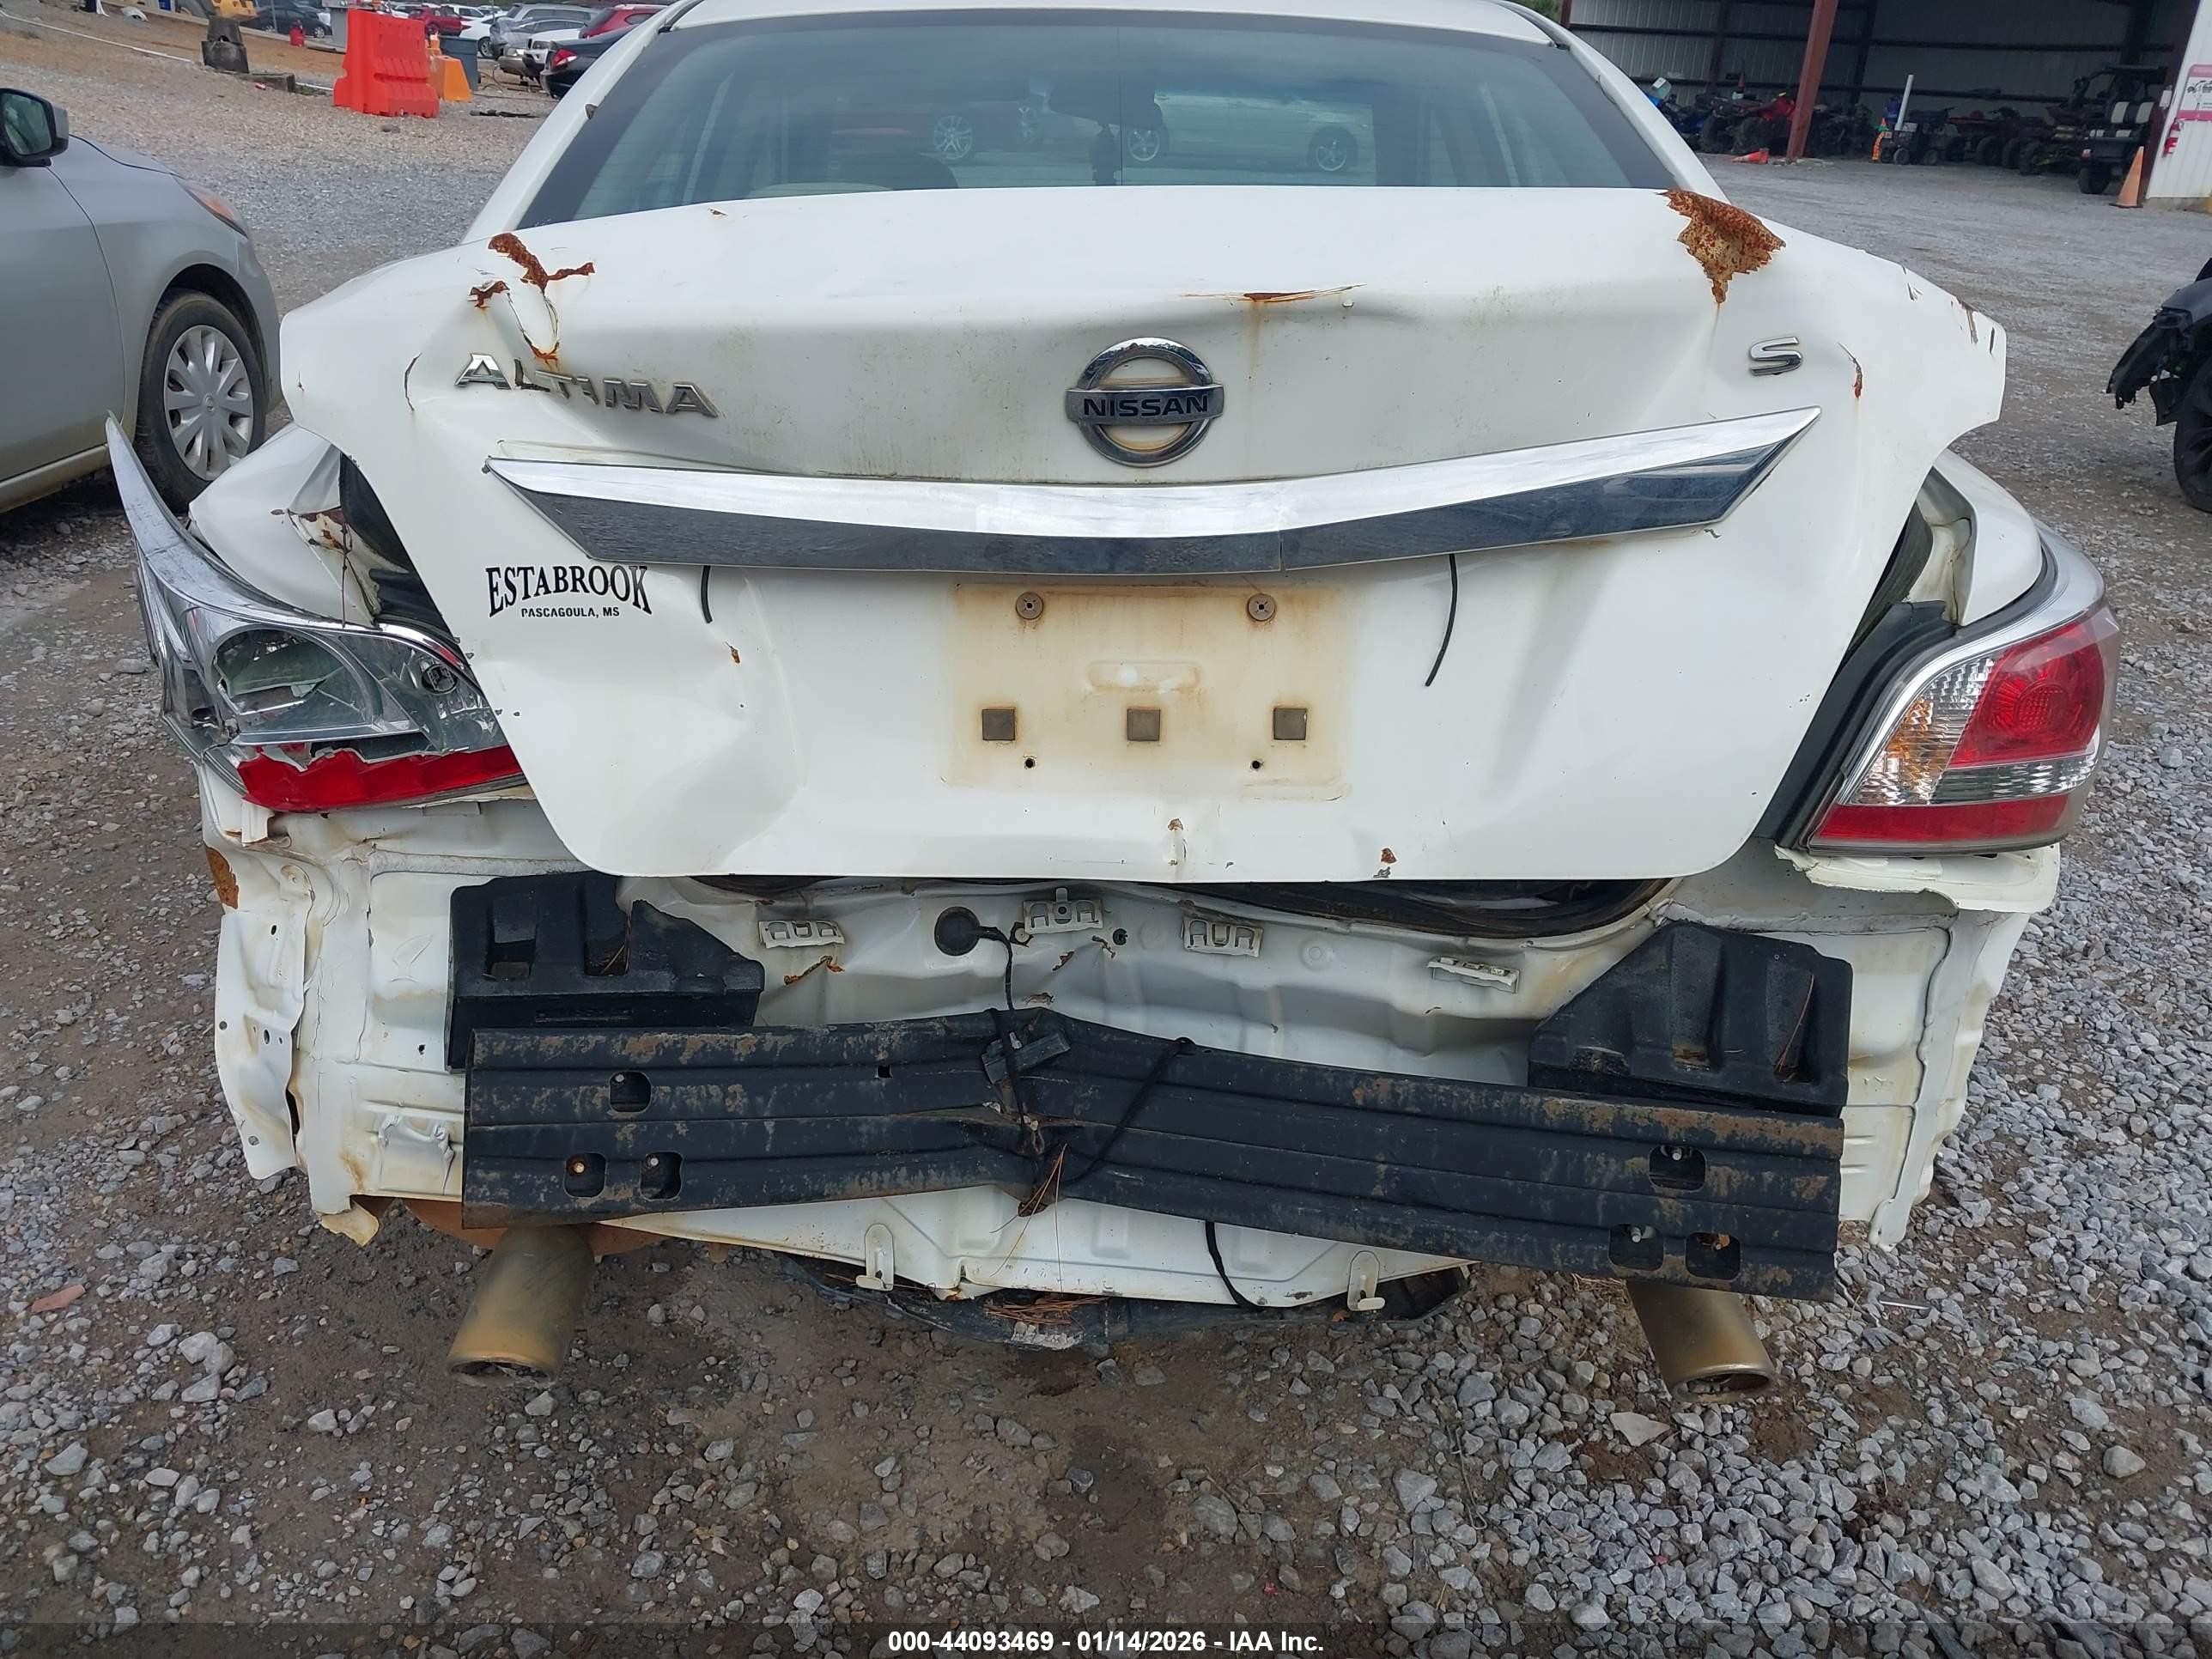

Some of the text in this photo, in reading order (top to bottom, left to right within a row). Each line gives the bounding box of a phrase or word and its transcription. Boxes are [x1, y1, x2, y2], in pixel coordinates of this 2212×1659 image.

[1749, 336, 1802, 376] S
[455, 353, 720, 418] ALTIMA
[1084, 395, 1208, 417] NISSAN
[485, 565, 653, 617] ESTABROOK
[521, 607, 620, 618] PASCAGOULA, MS
